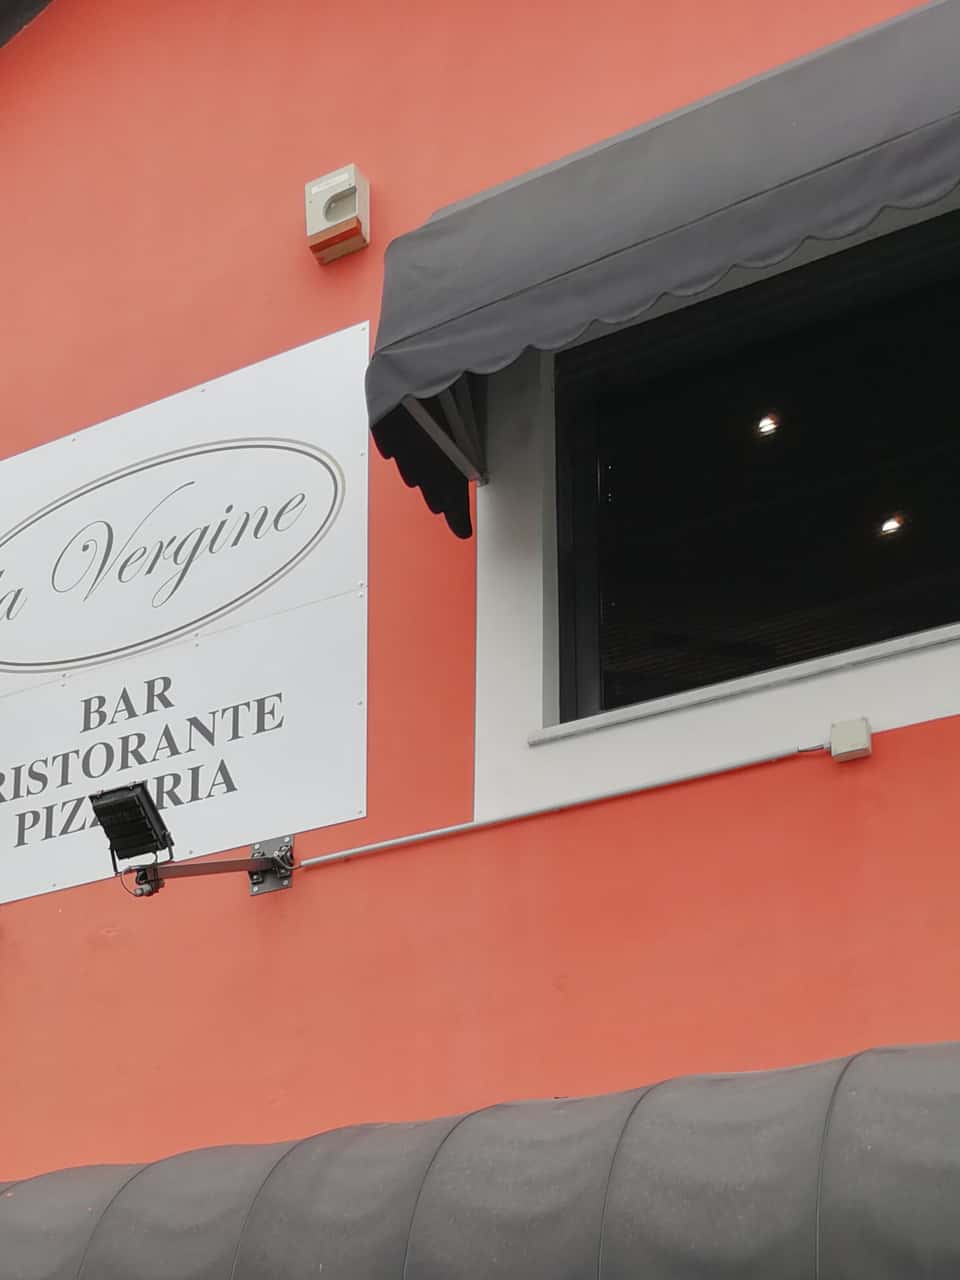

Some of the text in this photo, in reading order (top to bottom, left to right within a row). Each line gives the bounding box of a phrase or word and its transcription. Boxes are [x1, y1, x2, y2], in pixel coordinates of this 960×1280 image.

[51, 481, 307, 609] Vergine
[79, 674, 176, 733] BAR
[13, 758, 239, 849] PIZRIA
